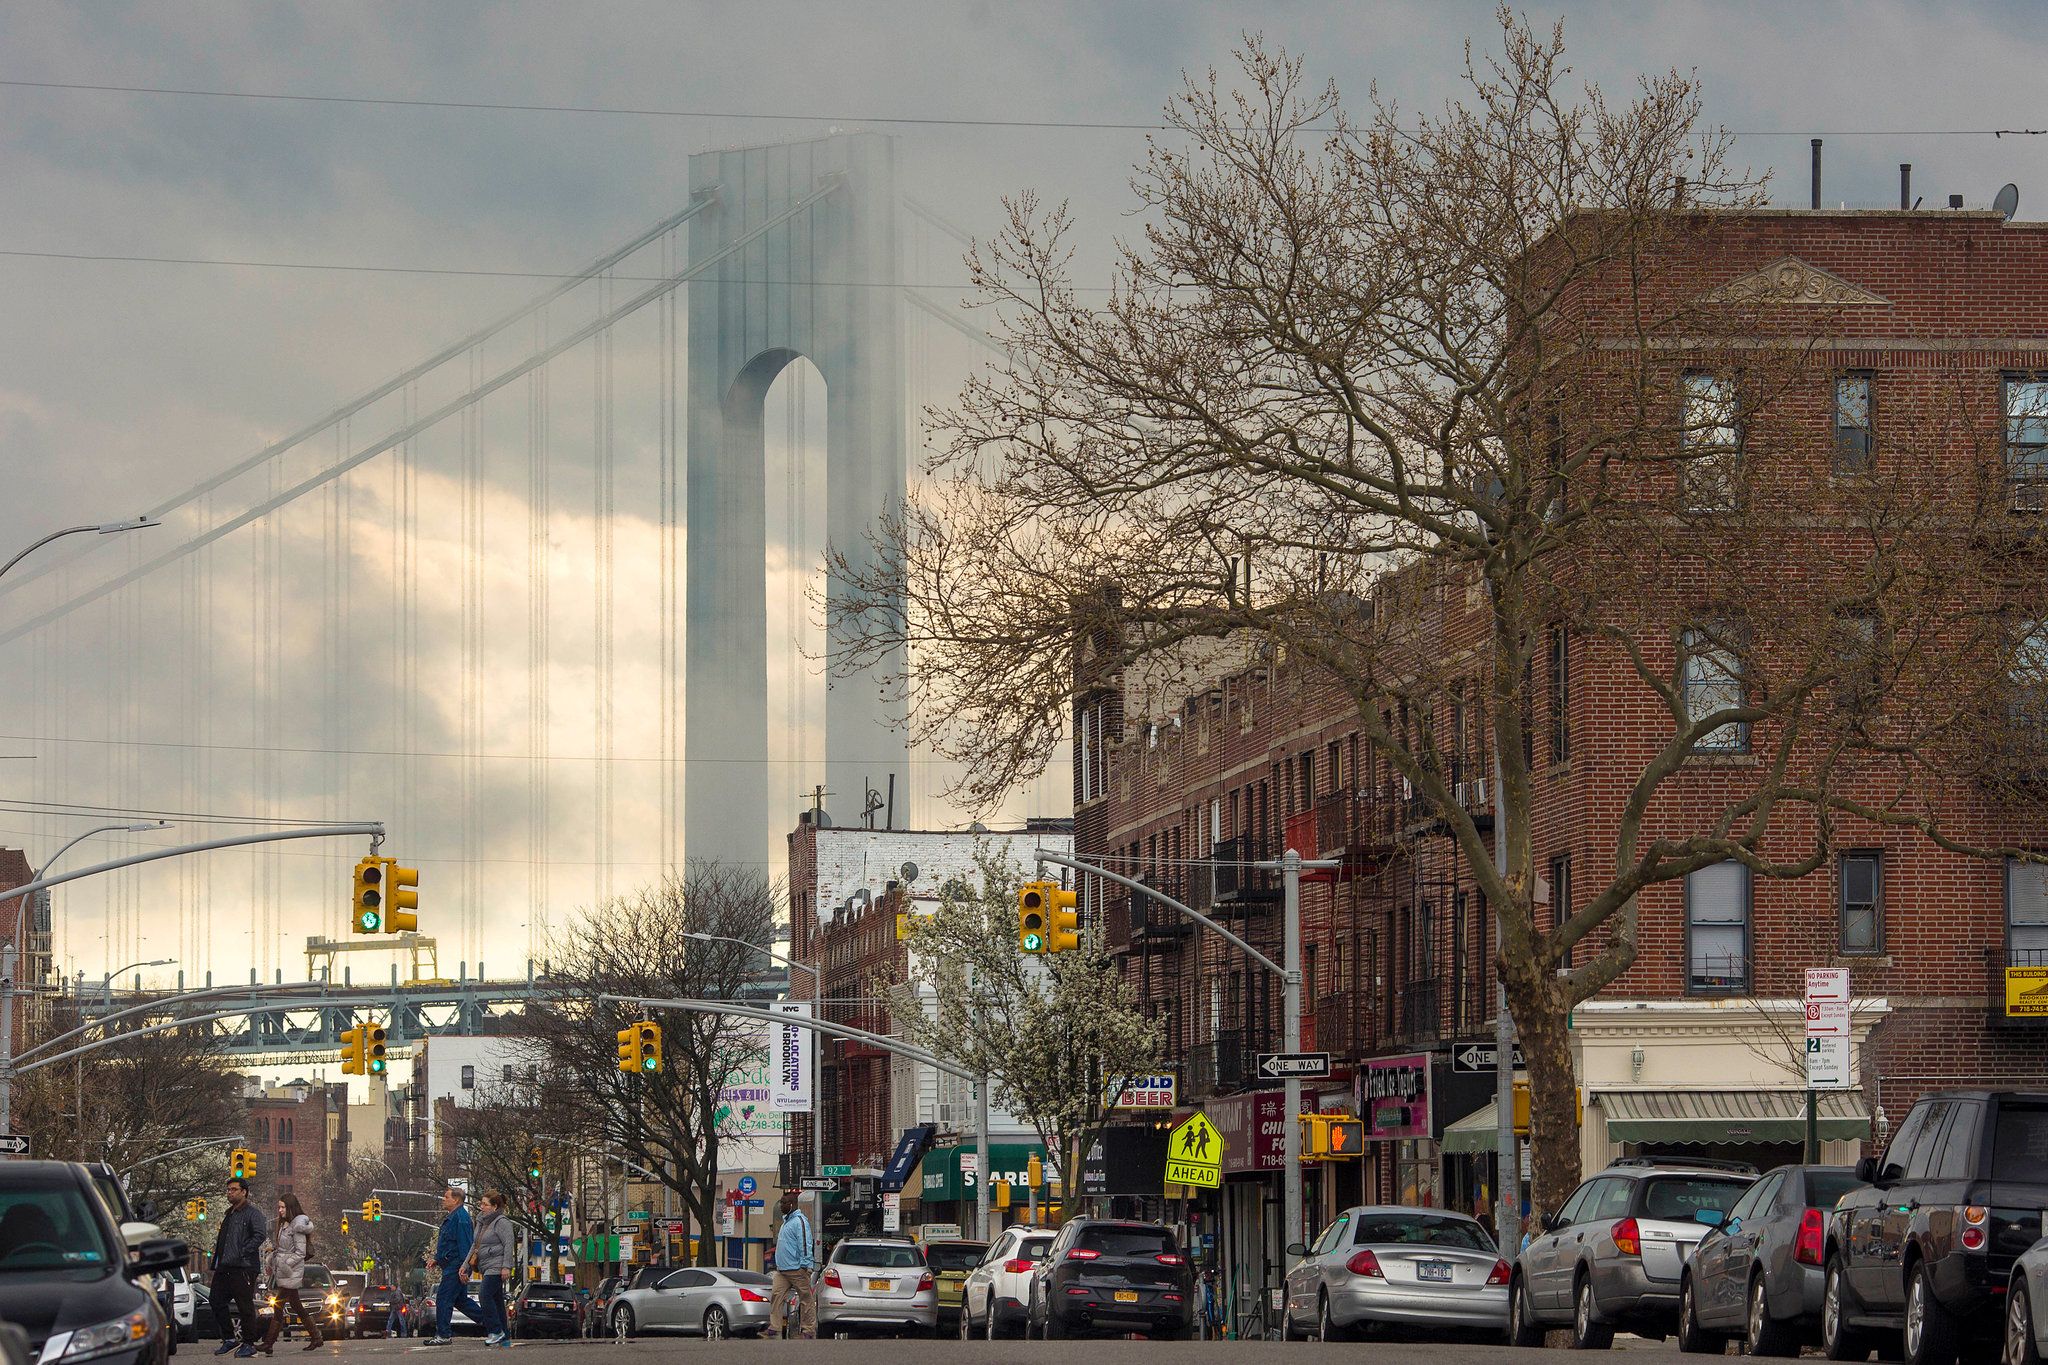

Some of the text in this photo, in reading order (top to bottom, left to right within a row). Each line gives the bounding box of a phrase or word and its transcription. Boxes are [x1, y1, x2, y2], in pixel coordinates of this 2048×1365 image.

[1809, 1038, 1818, 1052] 2
[782, 1024, 791, 1086] N BROOKLYN.
[1466, 1052, 1491, 1063] ONE
[790, 1039, 800, 1092] LOCATIONS
[1268, 1060, 1320, 1070] ONE WAY
[1122, 1077, 1173, 1089] OLD
[1121, 1091, 1174, 1106] BEER
[6, 1140, 23, 1149] WAY
[828, 1167, 838, 1175] 92
[1172, 1166, 1214, 1182] AHEAD
[805, 1179, 835, 1187] ONE WAY
